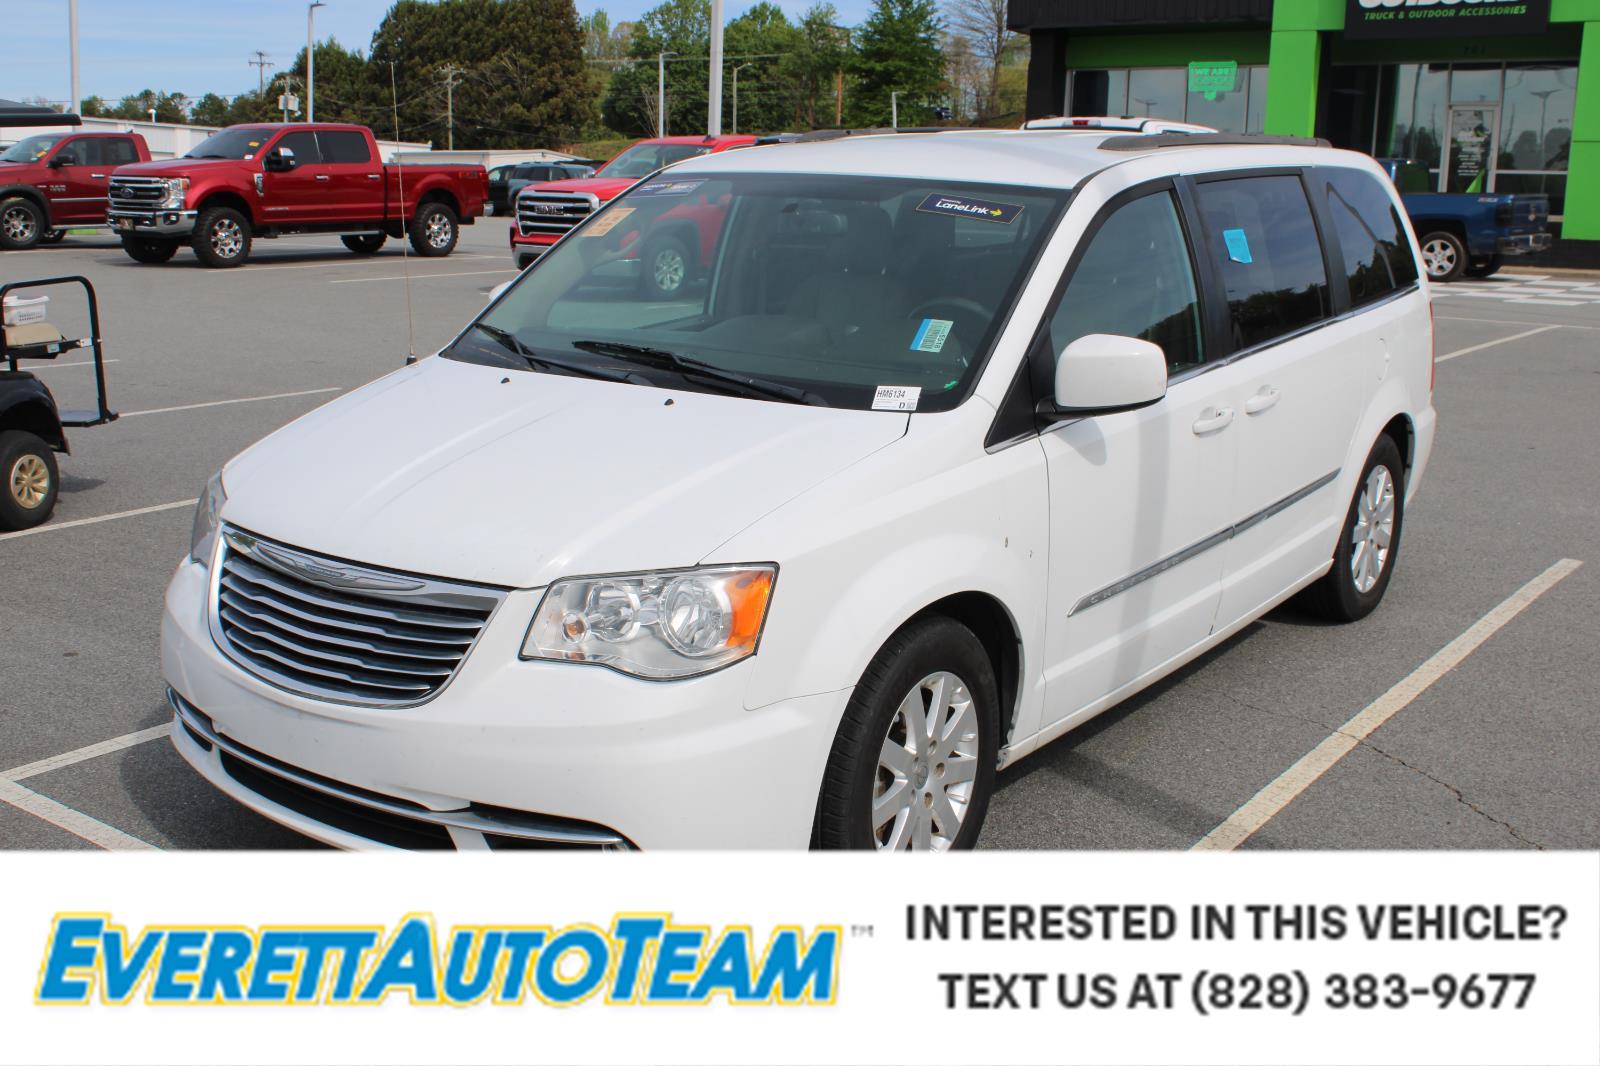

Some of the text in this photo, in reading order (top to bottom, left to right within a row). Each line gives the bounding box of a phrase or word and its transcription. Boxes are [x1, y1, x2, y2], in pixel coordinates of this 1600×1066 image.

[1364, 5, 1527, 20] TRUCK & OUTDOOR ACCESSORIES
[935, 200, 989, 215] LaneLink
[877, 390, 906, 398] HM6134
